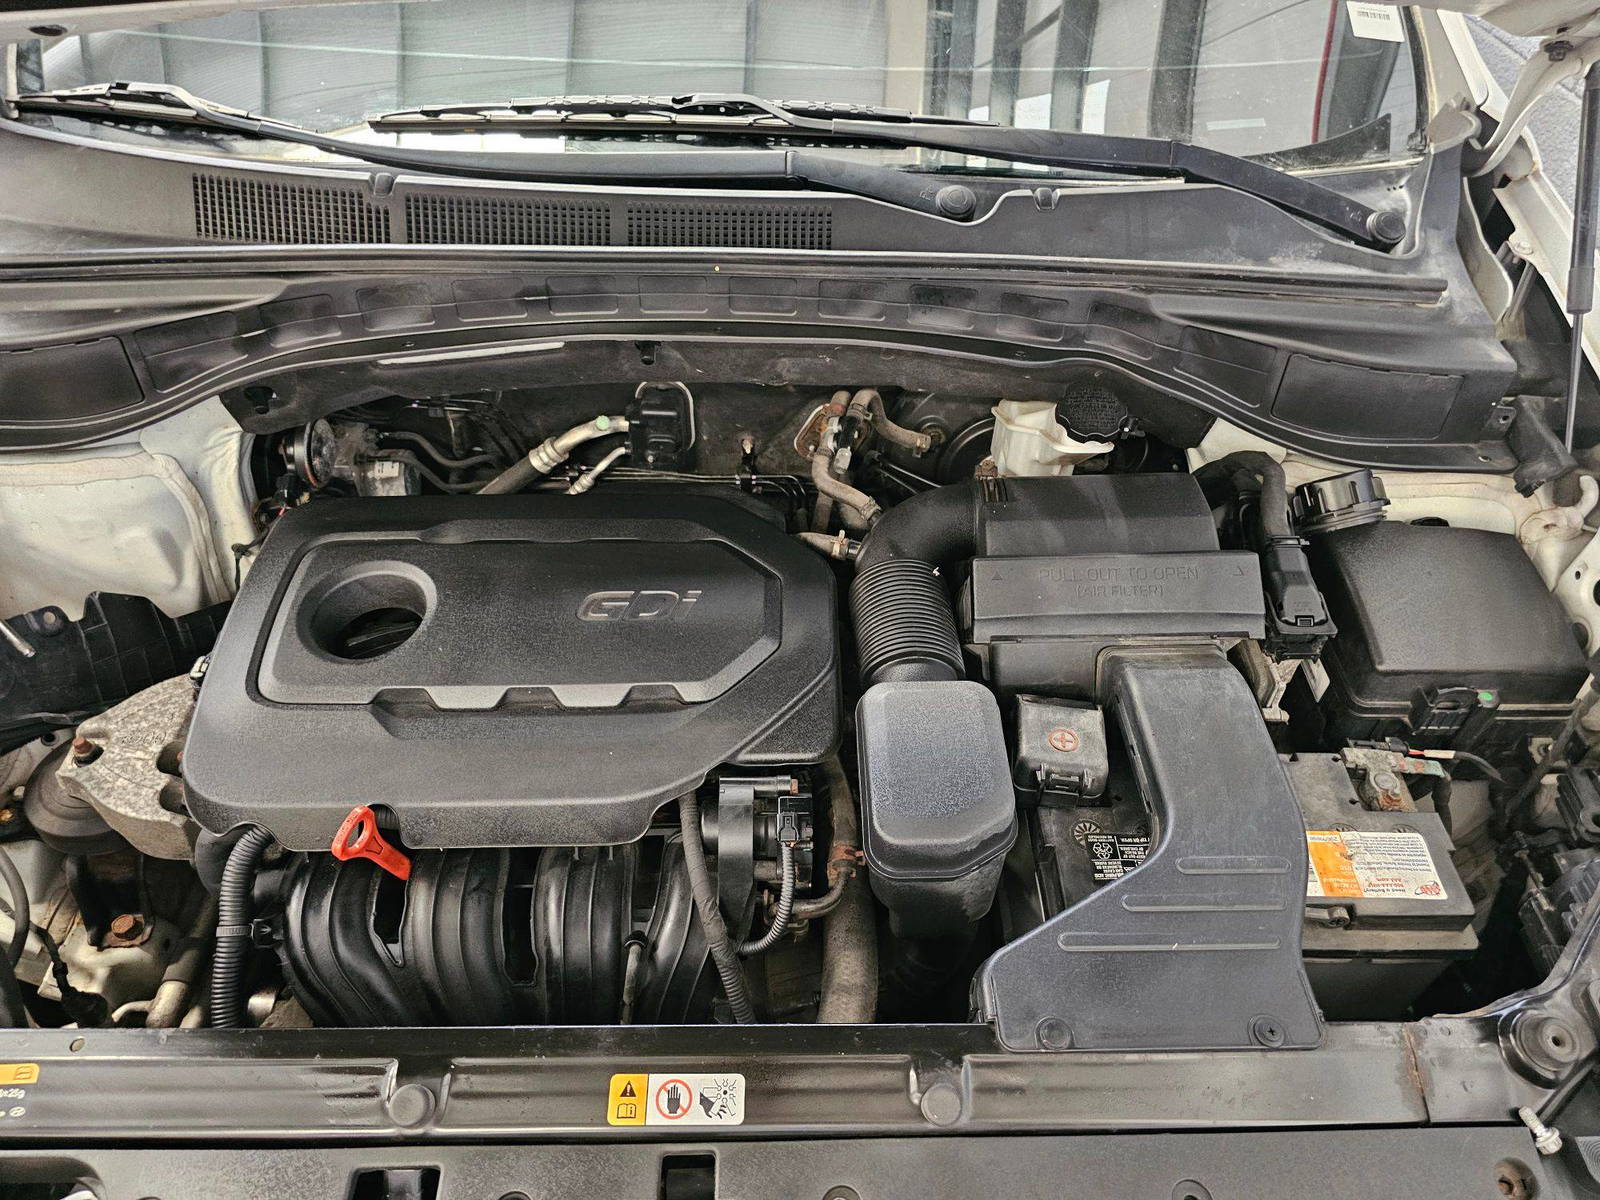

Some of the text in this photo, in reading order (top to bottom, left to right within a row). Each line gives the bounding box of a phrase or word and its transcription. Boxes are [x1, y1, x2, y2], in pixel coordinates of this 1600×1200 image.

[1038, 566, 1200, 582] PULL OUT TO OPEN
[1076, 584, 1164, 598] (AIR FILTER)
